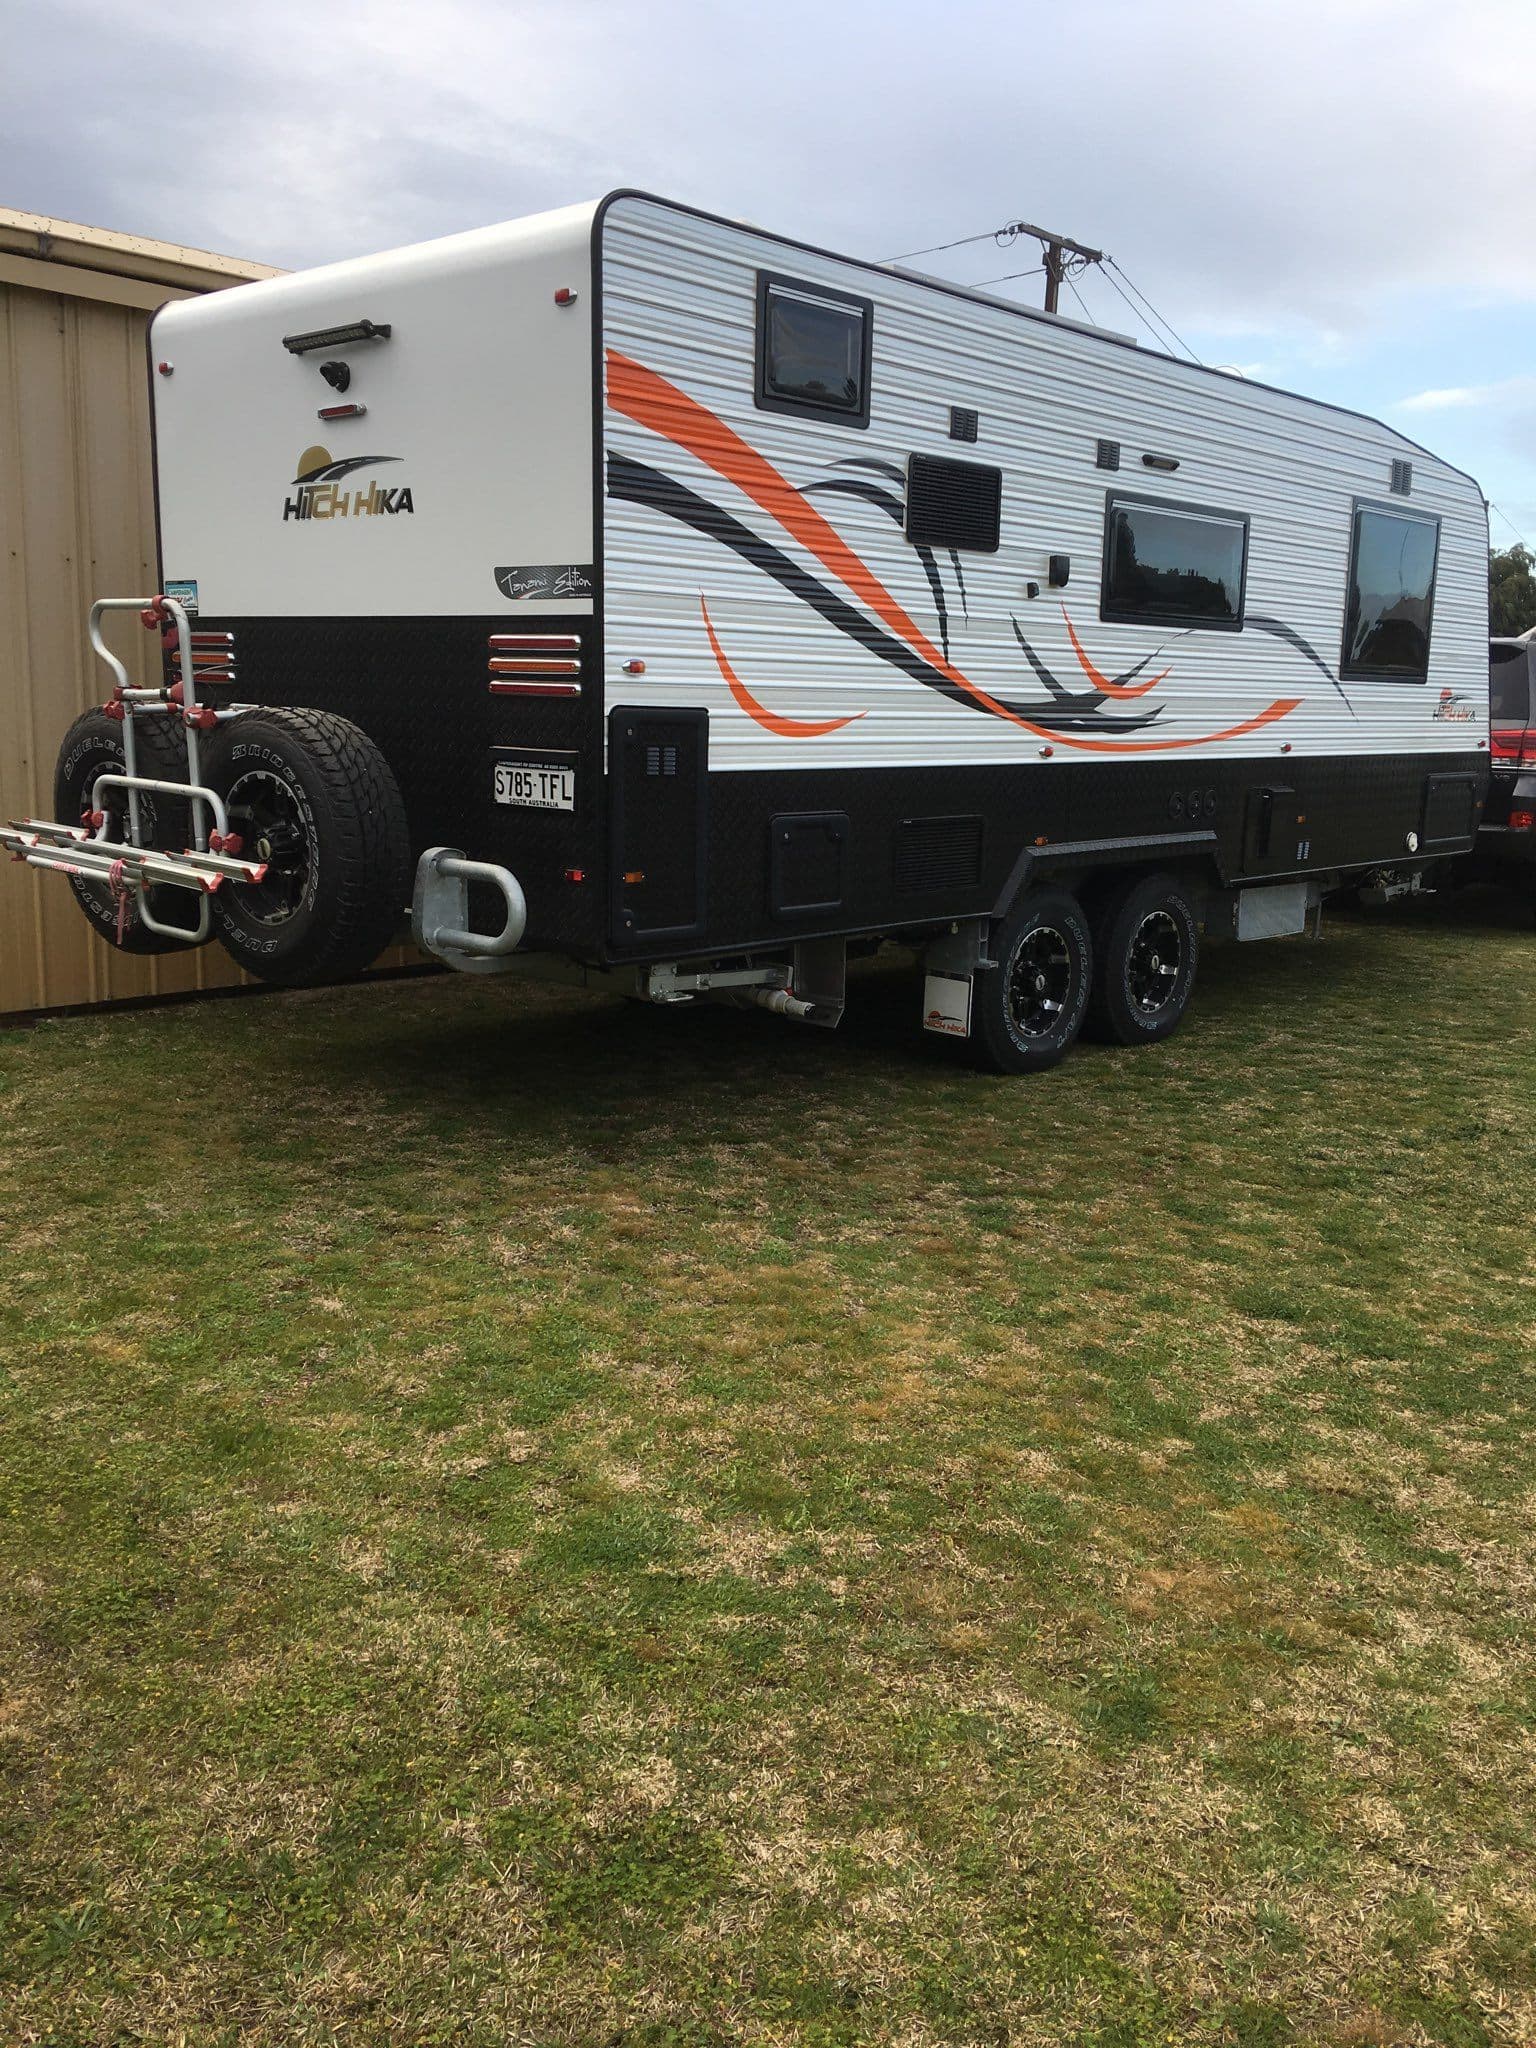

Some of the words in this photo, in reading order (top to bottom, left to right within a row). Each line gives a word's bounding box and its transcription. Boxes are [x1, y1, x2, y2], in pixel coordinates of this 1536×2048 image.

[501, 570, 547, 595] Tanami
[553, 566, 592, 595] Edition
[509, 798, 527, 806] SOUTH
[529, 799, 559, 808] AUSTRALIA
